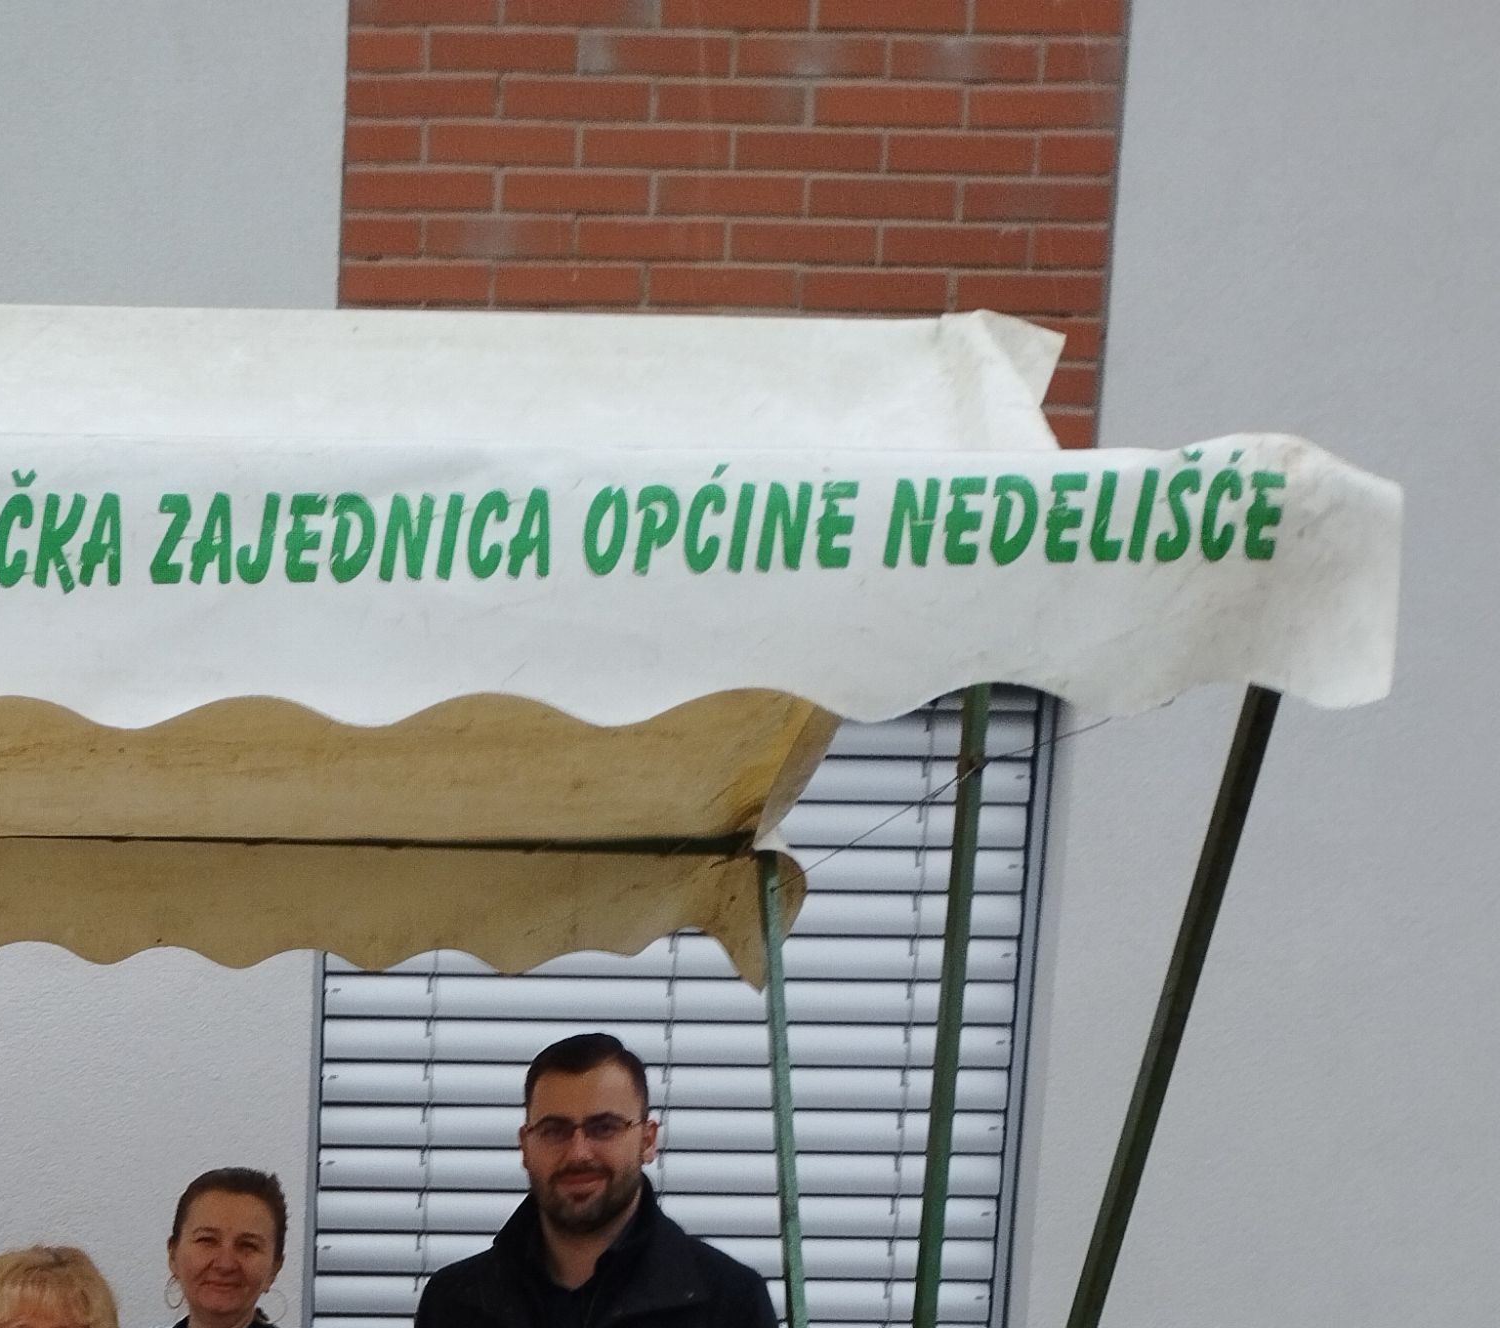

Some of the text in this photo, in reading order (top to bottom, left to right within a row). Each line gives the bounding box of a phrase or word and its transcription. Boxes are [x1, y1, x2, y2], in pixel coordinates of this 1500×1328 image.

[149, 488, 552, 585] ZAJEDNICA
[583, 464, 860, 577] OPĆINE
[882, 449, 1288, 568] NEDELIŠĆE
